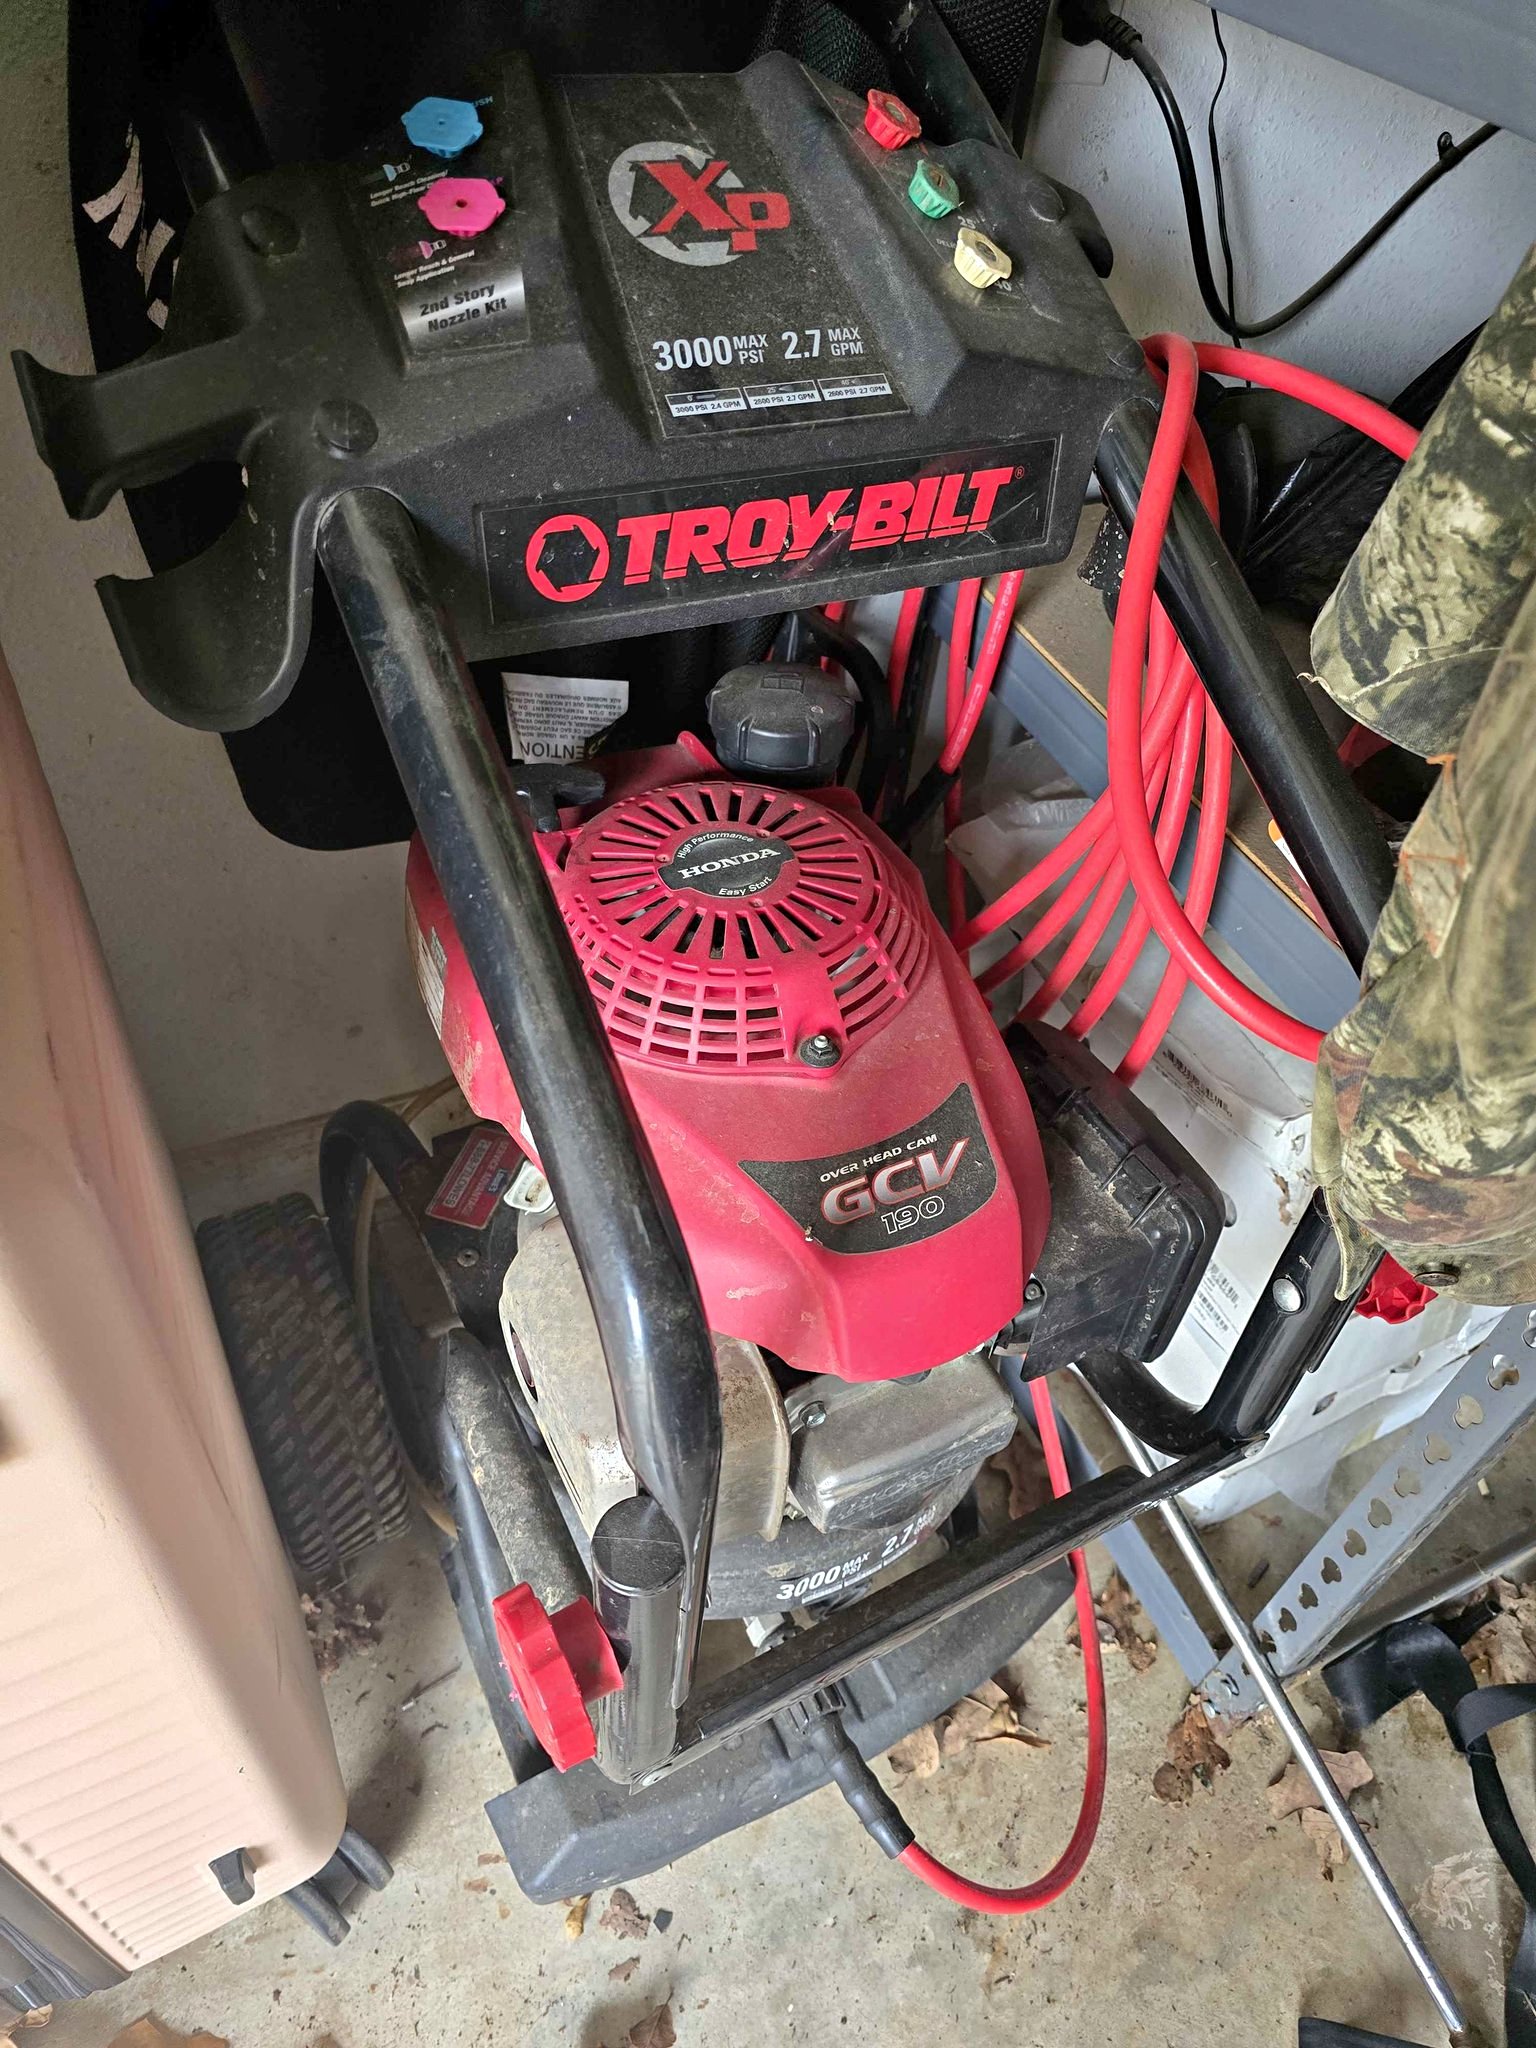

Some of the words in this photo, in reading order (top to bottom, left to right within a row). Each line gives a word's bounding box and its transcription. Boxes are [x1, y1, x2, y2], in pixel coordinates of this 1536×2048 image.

[420, 297, 449, 317] 2nd
[454, 284, 495, 304] Story
[428, 308, 481, 332] Nozzle
[485, 297, 507, 316] Kit
[652, 335, 733, 371] 3000
[732, 334, 769, 350] MAX
[781, 329, 821, 360] 2.7
[828, 327, 861, 342] MAX
[739, 350, 764, 365] PSI
[831, 342, 863, 356] GPM
[798, 393, 815, 401] GPM
[870, 385, 886, 393] GPM
[723, 401, 741, 409] GPM
[519, 742, 585, 760] ENTION
[678, 842, 693, 859] High
[691, 832, 754, 845] Performance
[678, 848, 781, 879] HONDA
[718, 888, 747, 896] Easy
[748, 876, 772, 892] Start
[820, 1163, 859, 1183] OVER
[863, 1146, 902, 1167] HEAD
[906, 1134, 938, 1151] CAM
[821, 1136, 970, 1225] GCV
[881, 1195, 945, 1235] 190
[776, 1566, 841, 1600] 3000
[882, 1523, 914, 1557] 2.7
